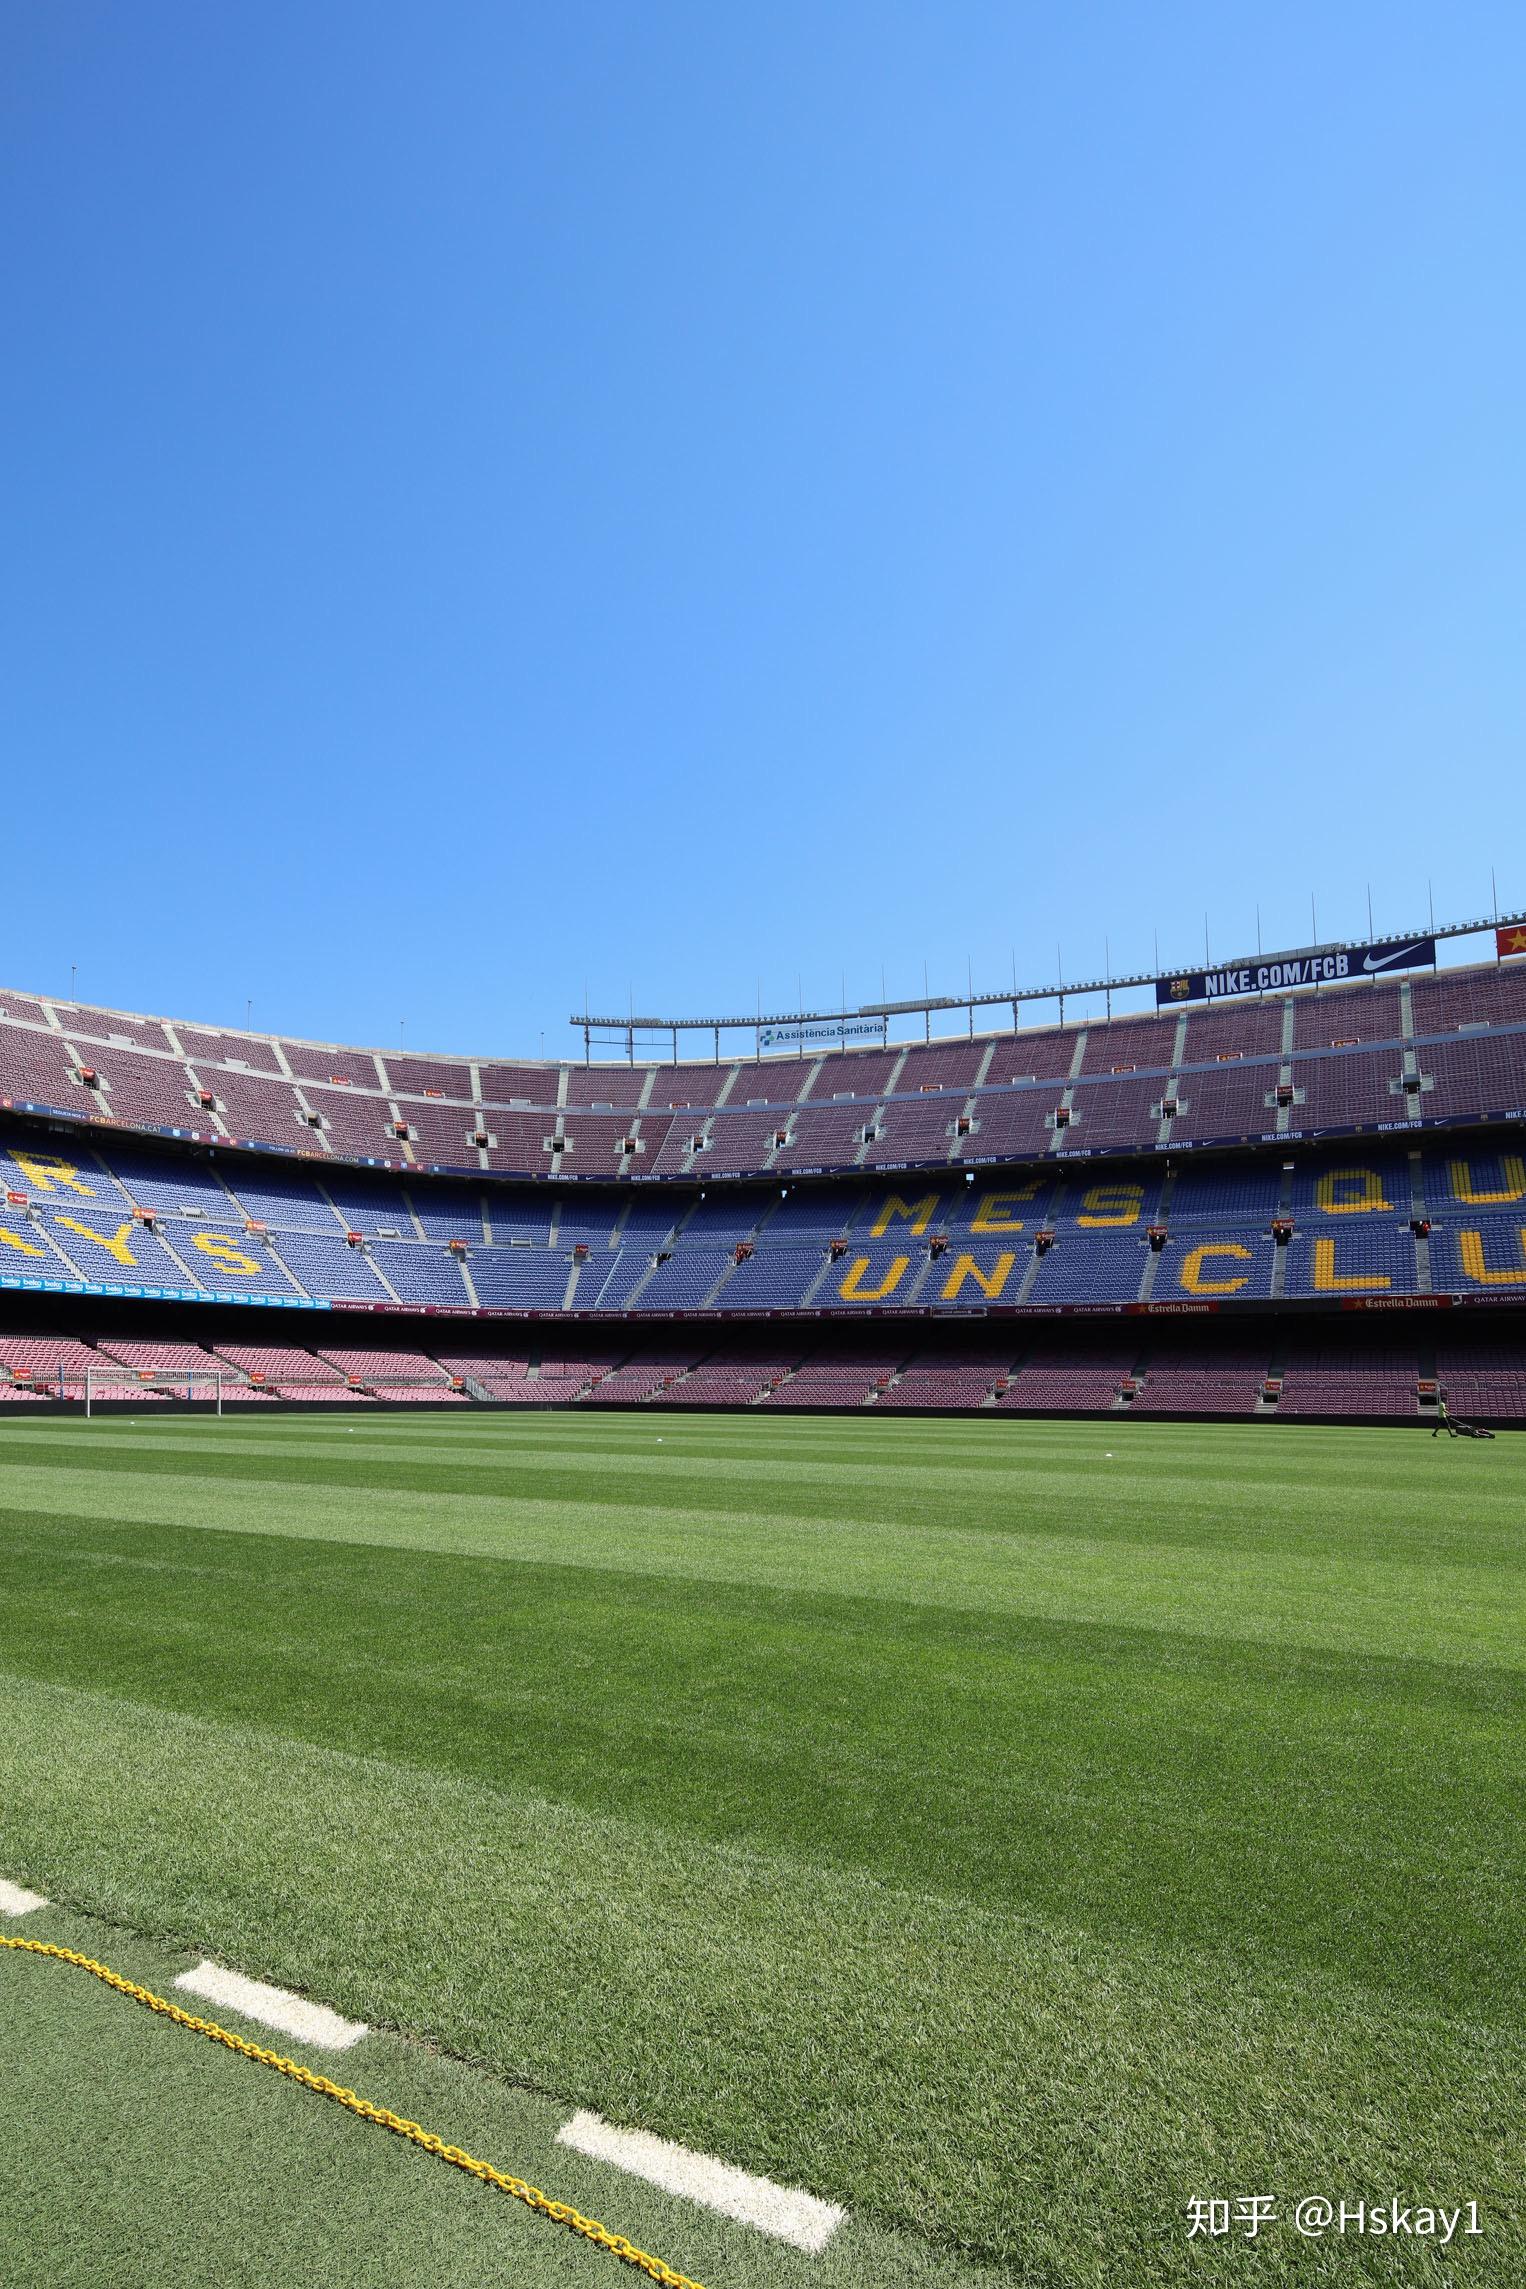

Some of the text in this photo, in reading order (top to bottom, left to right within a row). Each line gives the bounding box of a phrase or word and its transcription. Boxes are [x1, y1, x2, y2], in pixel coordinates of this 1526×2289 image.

[1204, 954, 1349, 997] NIKE.COM/FCB
[776, 1024, 883, 1040] Assistència Sanitària
[90, 1115, 161, 1133] FCBARCELONA.CAT
[1378, 1120, 1423, 1131] NIKE.COM/FCB
[1261, 1132, 1302, 1141] NIKE.COM/FCB
[1155, 1141, 1193, 1150] NIKE.COM/FCB
[297, 1150, 359, 1163] FCBARCELONA.COM
[838, 1253, 1016, 1300] UN
[2, 1277, 20, 1285] beko
[23, 1279, 41, 1287] beko
[45, 1280, 62, 1289] beko
[66, 1282, 83, 1290] beko
[86, 1283, 102, 1291] beko
[106, 1285, 123, 1293] beko
[125, 1286, 141, 1294] beko
[144, 1288, 160, 1296] beko
[163, 1289, 179, 1297] beko
[234, 1294, 248, 1302] beko
[268, 1296, 282, 1304] beko
[300, 1298, 314, 1306] beko
[1365, 1298, 1438, 1308] Estrella Damm
[1148, 1304, 1209, 1313] Estrella Damm
